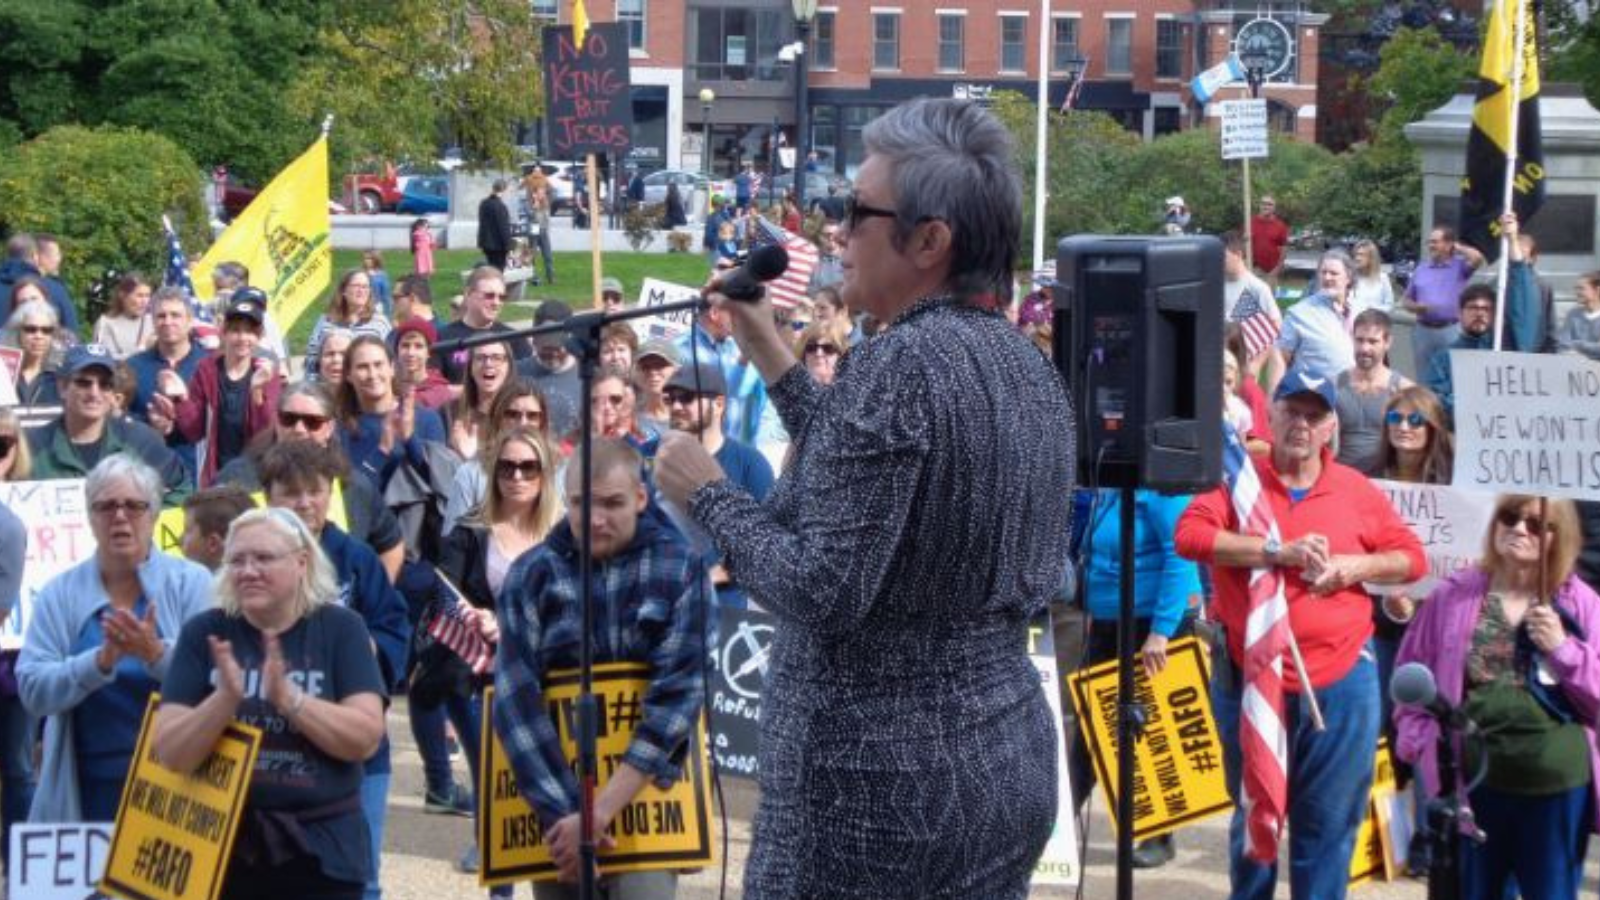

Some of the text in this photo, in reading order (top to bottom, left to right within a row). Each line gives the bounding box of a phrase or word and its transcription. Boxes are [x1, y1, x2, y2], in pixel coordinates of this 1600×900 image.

[558, 33, 608, 61] NO
[550, 62, 625, 102] KING
[556, 116, 630, 150] JESUS
[1485, 365, 1600, 397] HELL NO
[1475, 413, 1507, 440] WE
[1475, 448, 1600, 491] SOCIALIS
[1167, 685, 1220, 774] #FAFO
[1153, 754, 1182, 793] WILL
[621, 802, 649, 836] DO
[655, 801, 686, 834] WE
[1163, 790, 1189, 818] WE
[20, 828, 111, 888] FED
[131, 837, 194, 898] #FAFO
